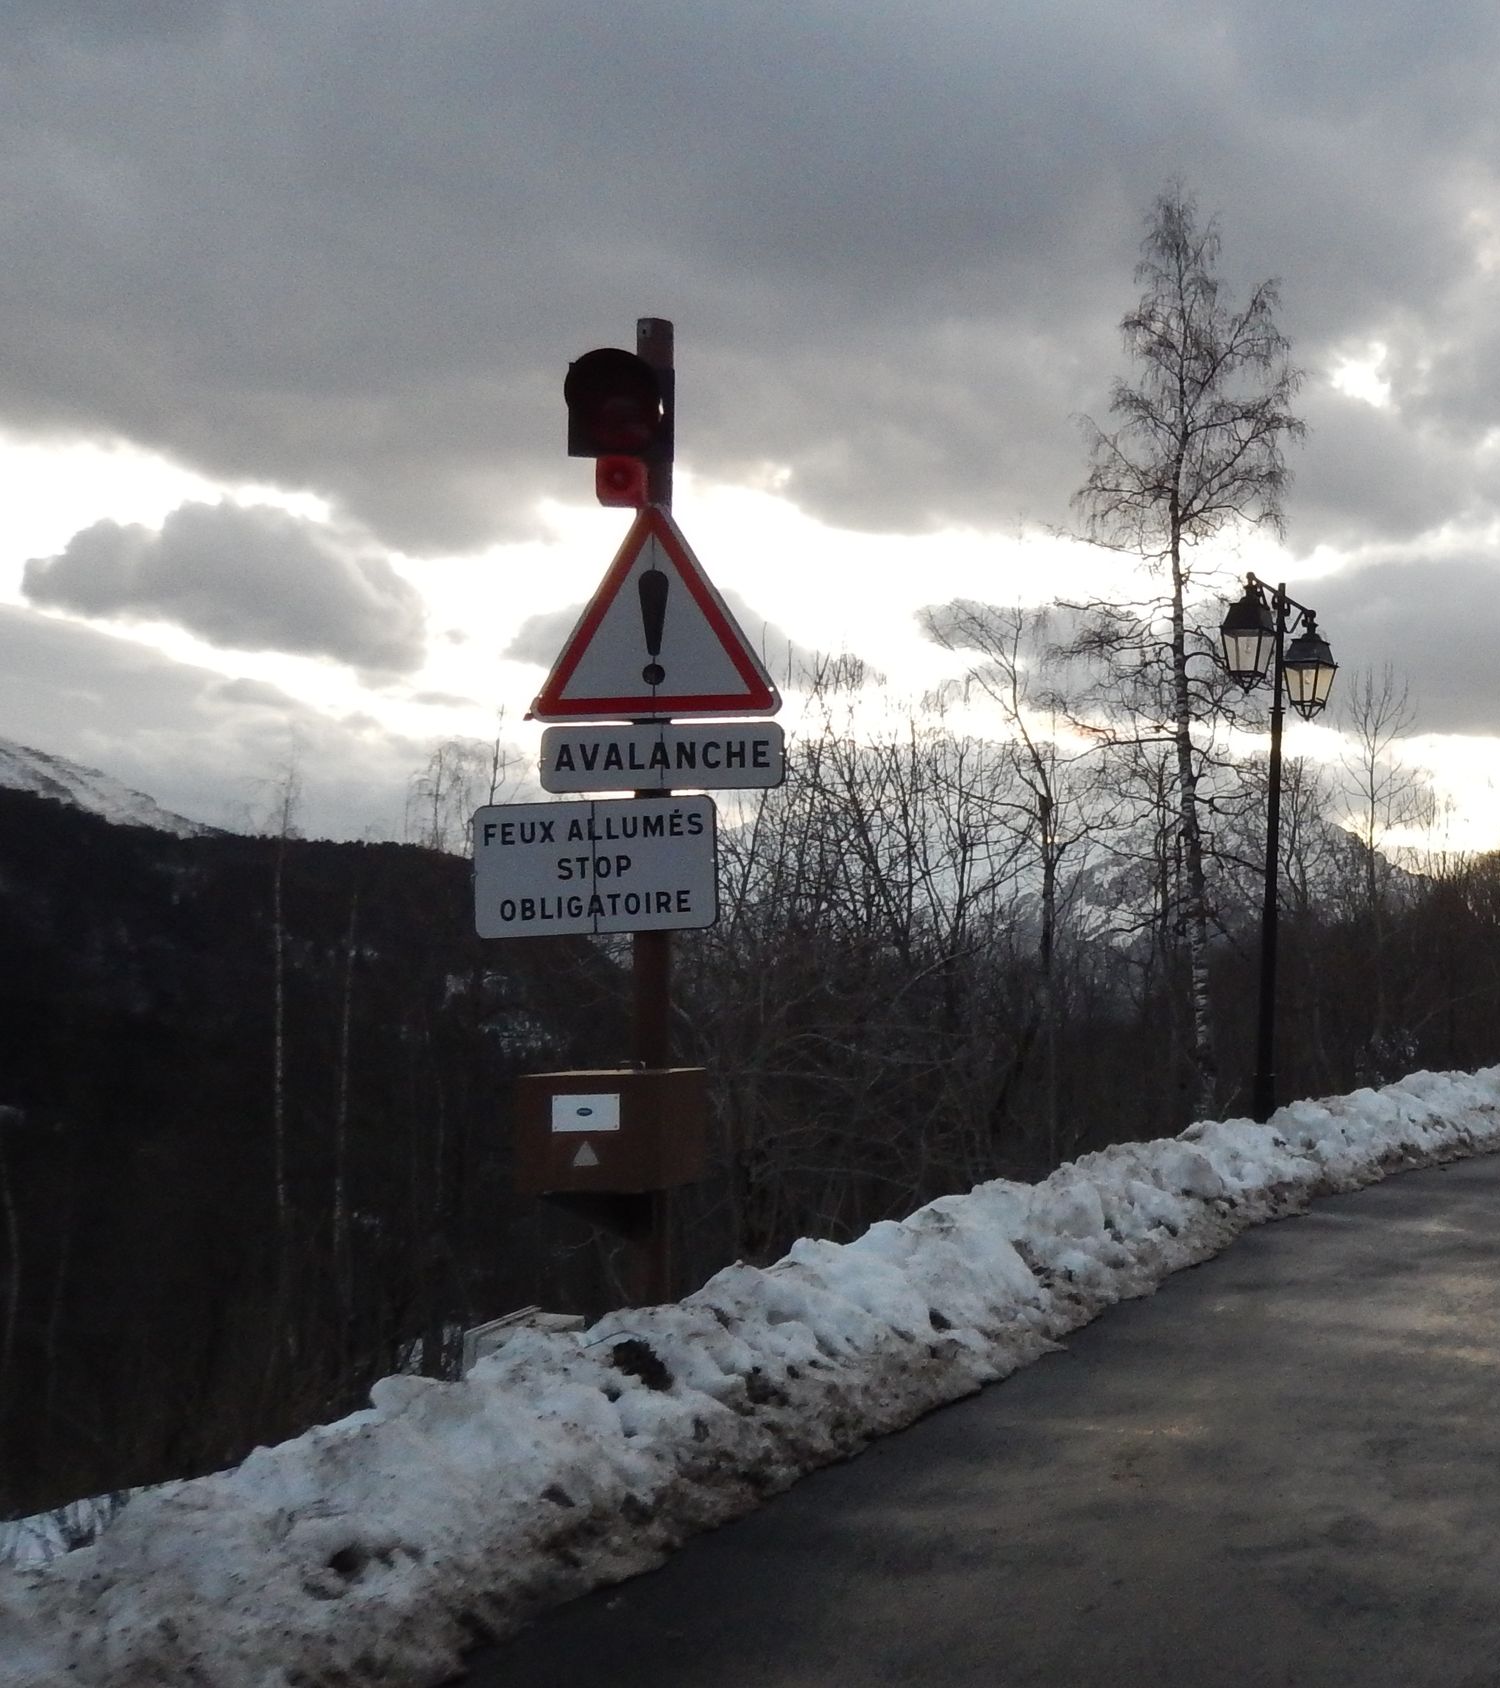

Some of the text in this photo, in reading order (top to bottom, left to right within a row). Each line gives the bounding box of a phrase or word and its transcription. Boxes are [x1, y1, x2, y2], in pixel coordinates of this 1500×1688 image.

[554, 739, 771, 772] AVALANCHE
[483, 808, 704, 846] FEUX ALLUMÉS
[557, 855, 632, 880] STOP
[499, 889, 692, 922] OBLIGATOIRE
